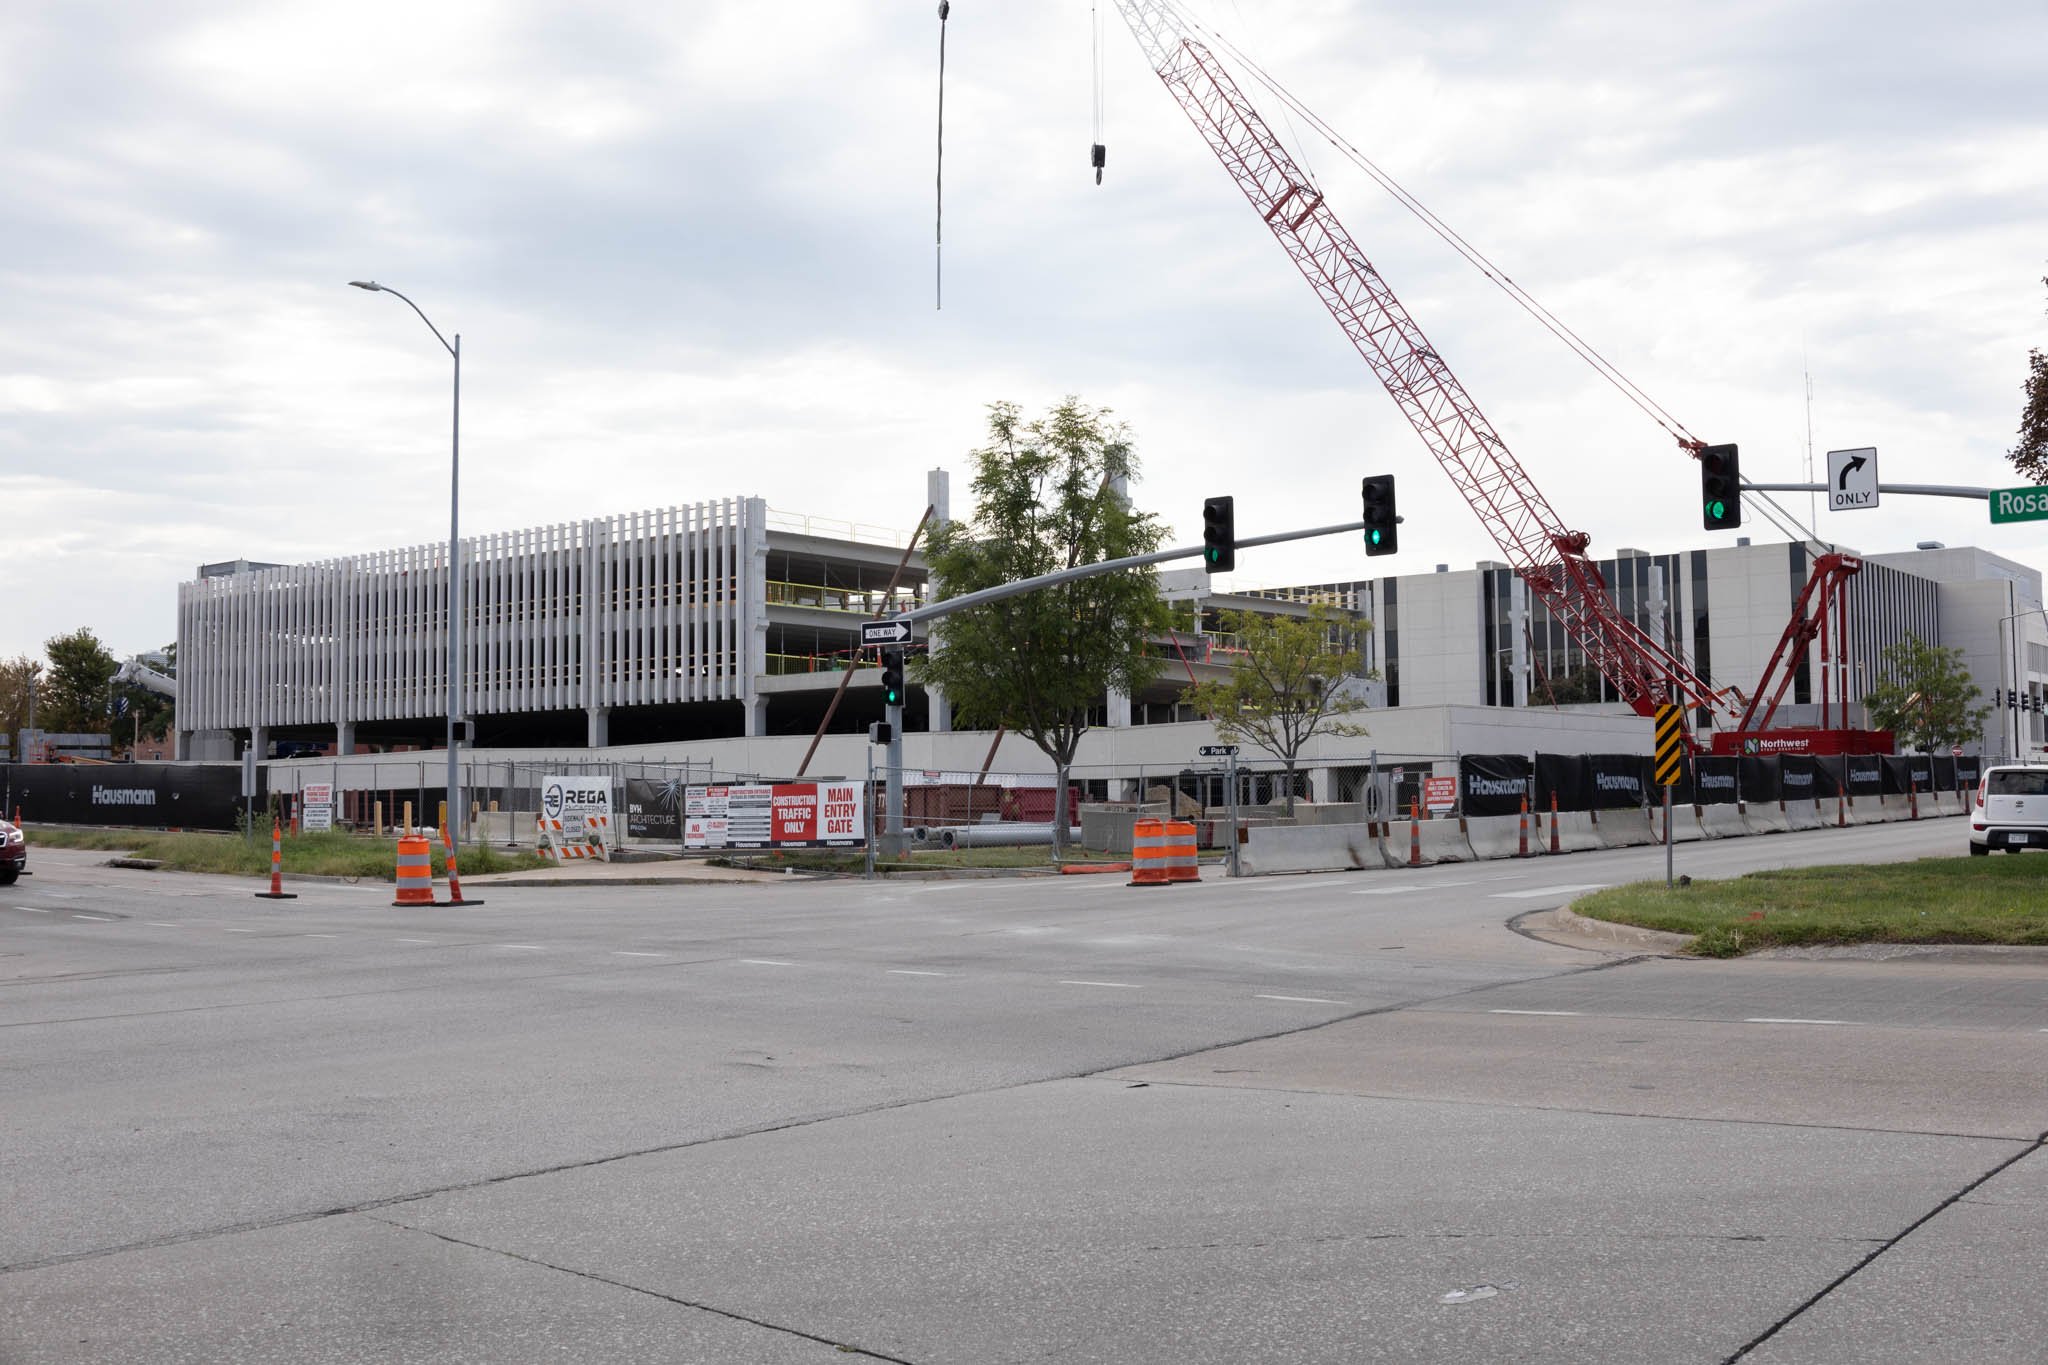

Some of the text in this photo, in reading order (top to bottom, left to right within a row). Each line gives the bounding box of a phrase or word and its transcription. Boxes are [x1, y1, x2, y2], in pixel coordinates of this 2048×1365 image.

[1836, 491, 1871, 505] ONLY
[2001, 490, 2048, 515] Rosa
[869, 628, 896, 638] ONE WAY
[1760, 738, 1809, 748] Northwest
[1210, 746, 1227, 755] Park
[1469, 775, 1527, 795] Hausmann
[1596, 772, 1640, 791] Hausmann
[1701, 771, 1734, 788] Hausmann
[92, 784, 156, 805] Hausmann
[565, 790, 607, 804] REGA
[828, 788, 853, 802] MAIN
[773, 796, 816, 806] CONSTRUCTION
[629, 803, 642, 814] BVH
[778, 808, 812, 820] TRAFFIC
[824, 803, 856, 817] ENTRY
[630, 814, 676, 825] ARCHITECTURE
[565, 825, 581, 833] CLOSED
[692, 824, 700, 832] NO
[784, 821, 805, 834] ONLY
[827, 819, 853, 833] GATE
[735, 841, 761, 849] Hausmann
[780, 840, 807, 848] Hausmann
[826, 839, 854, 847] Hausmann
